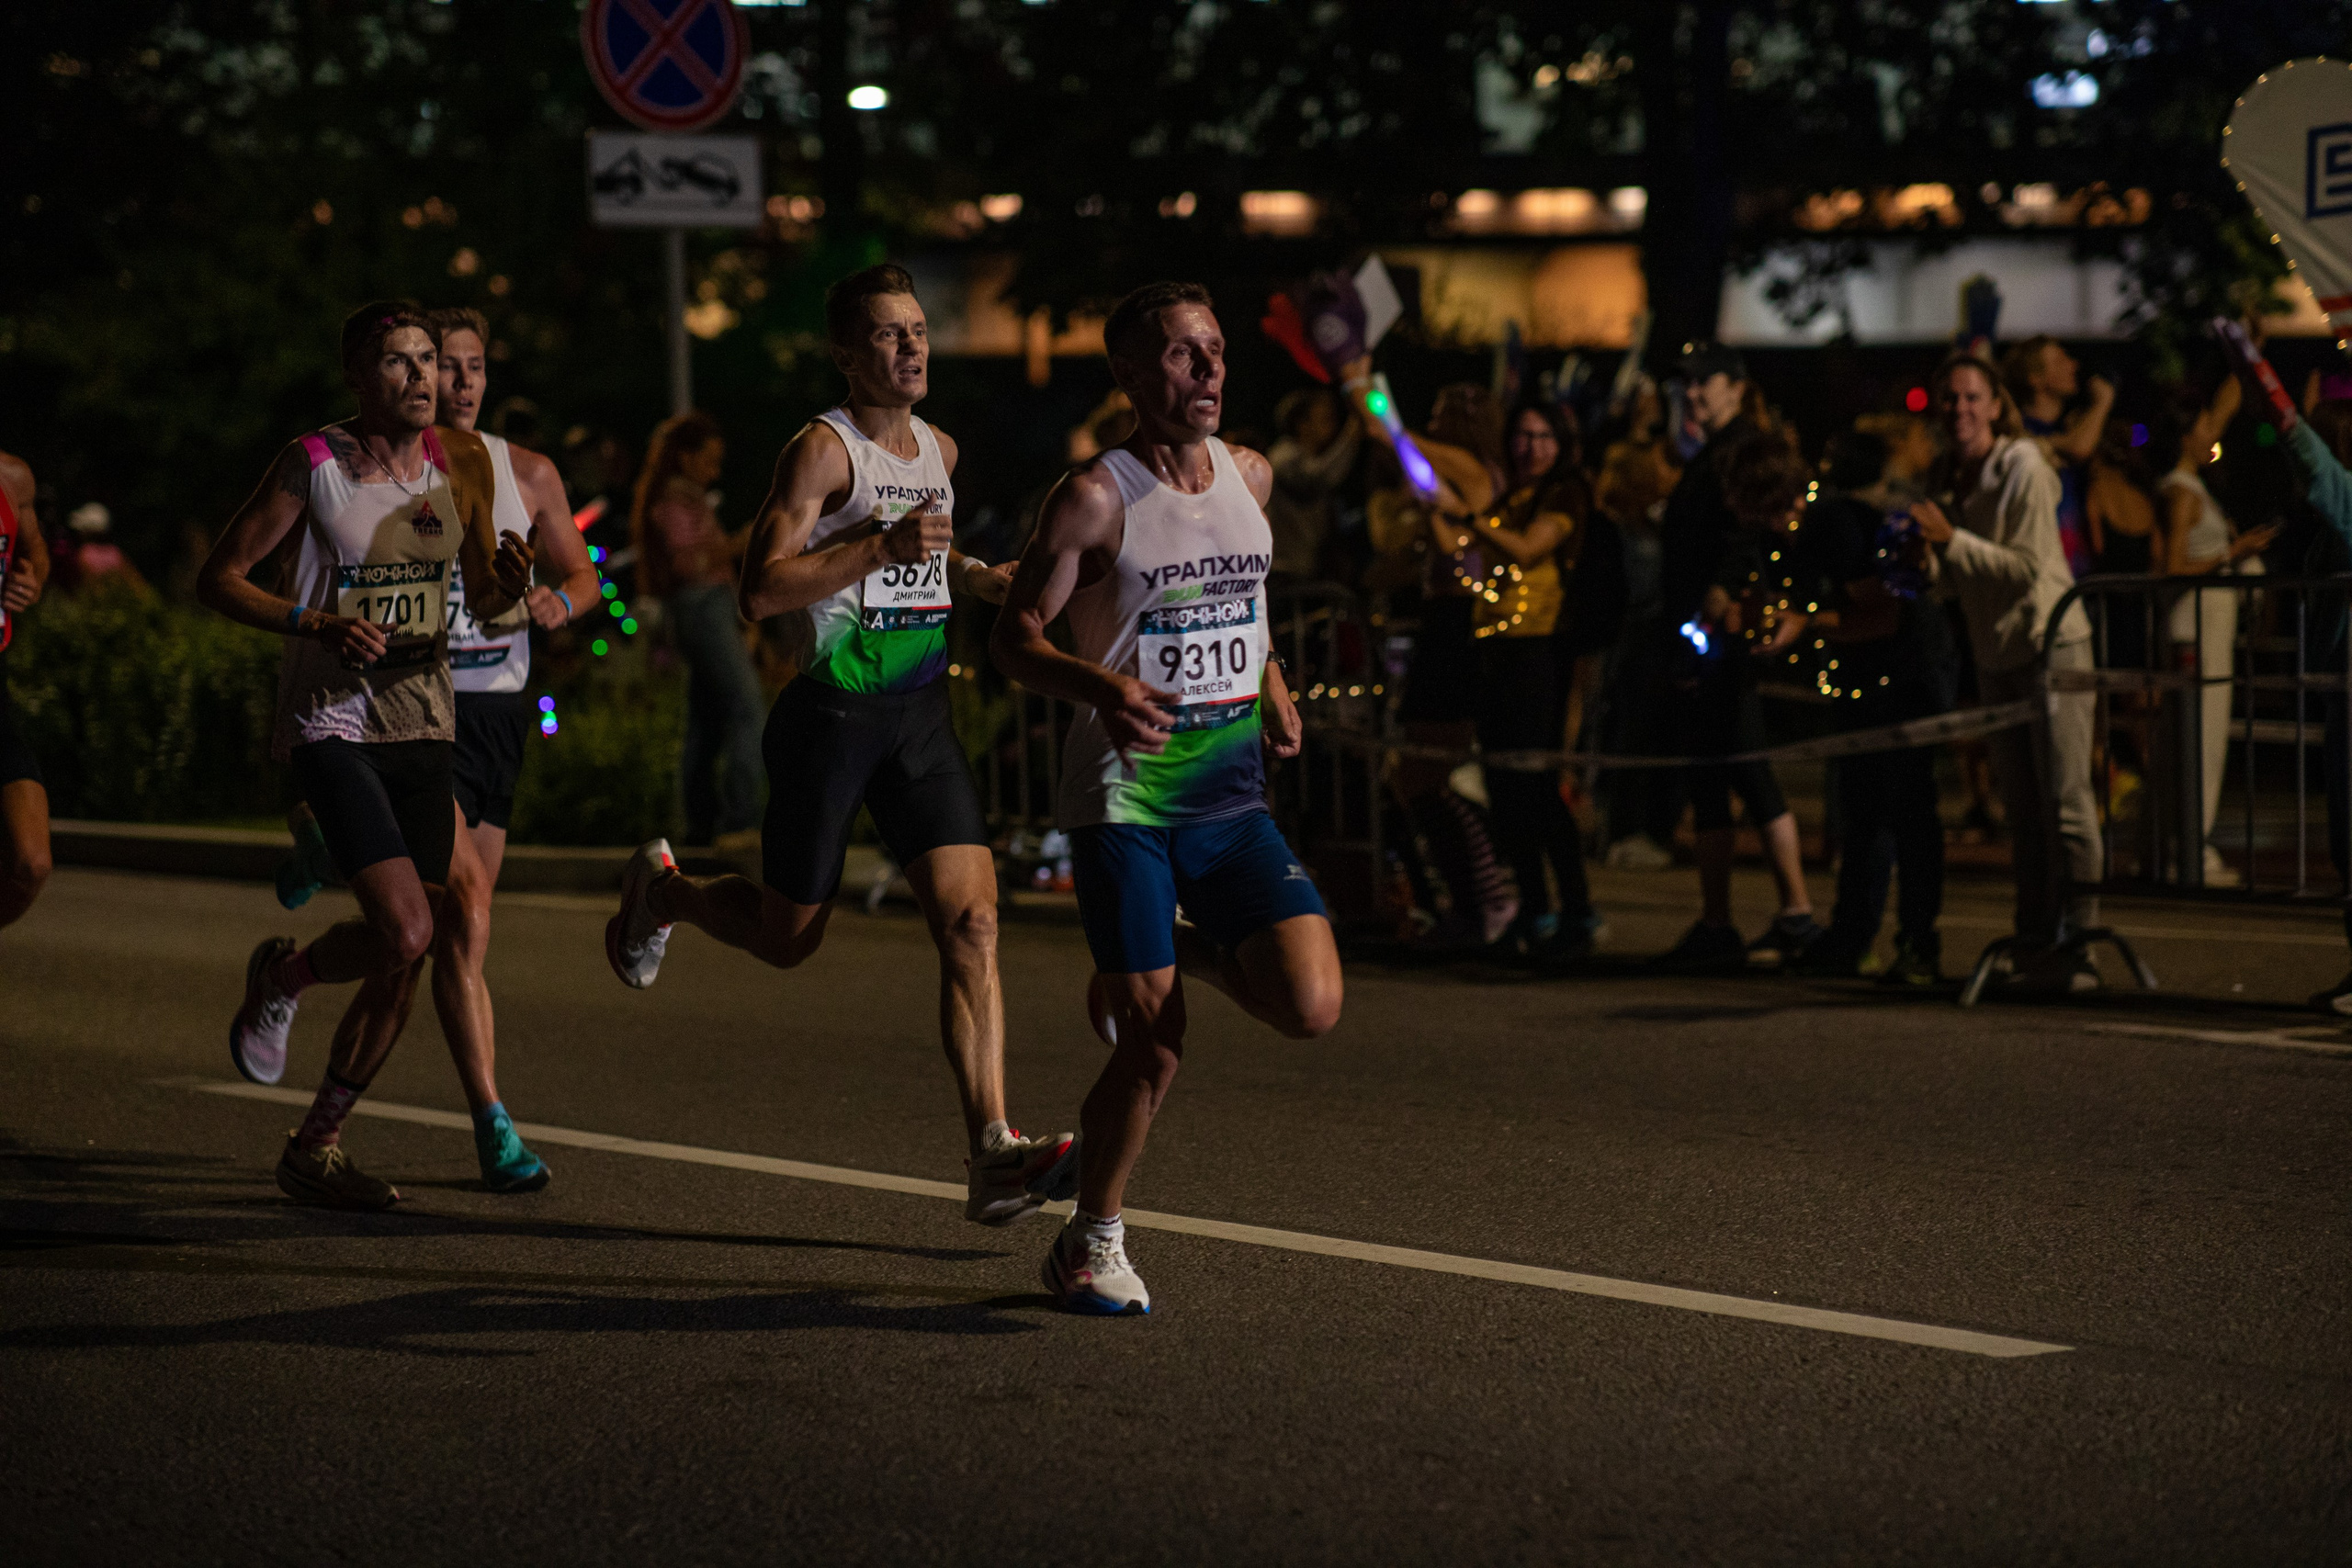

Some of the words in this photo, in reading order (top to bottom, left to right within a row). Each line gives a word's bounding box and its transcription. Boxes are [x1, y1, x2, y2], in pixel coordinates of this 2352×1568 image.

[352, 561, 436, 583] НОЧНОЙ
[882, 553, 942, 588] 5678
[1140, 553, 1270, 590] УРАЛХИМ
[356, 592, 425, 626] 1701
[893, 589, 936, 603] ДМИТРИЙ
[1151, 598, 1250, 628] НОЧНОЙ
[1159, 637, 1247, 682] 9310
[1181, 679, 1233, 696] АЛЕКСЕЙ
